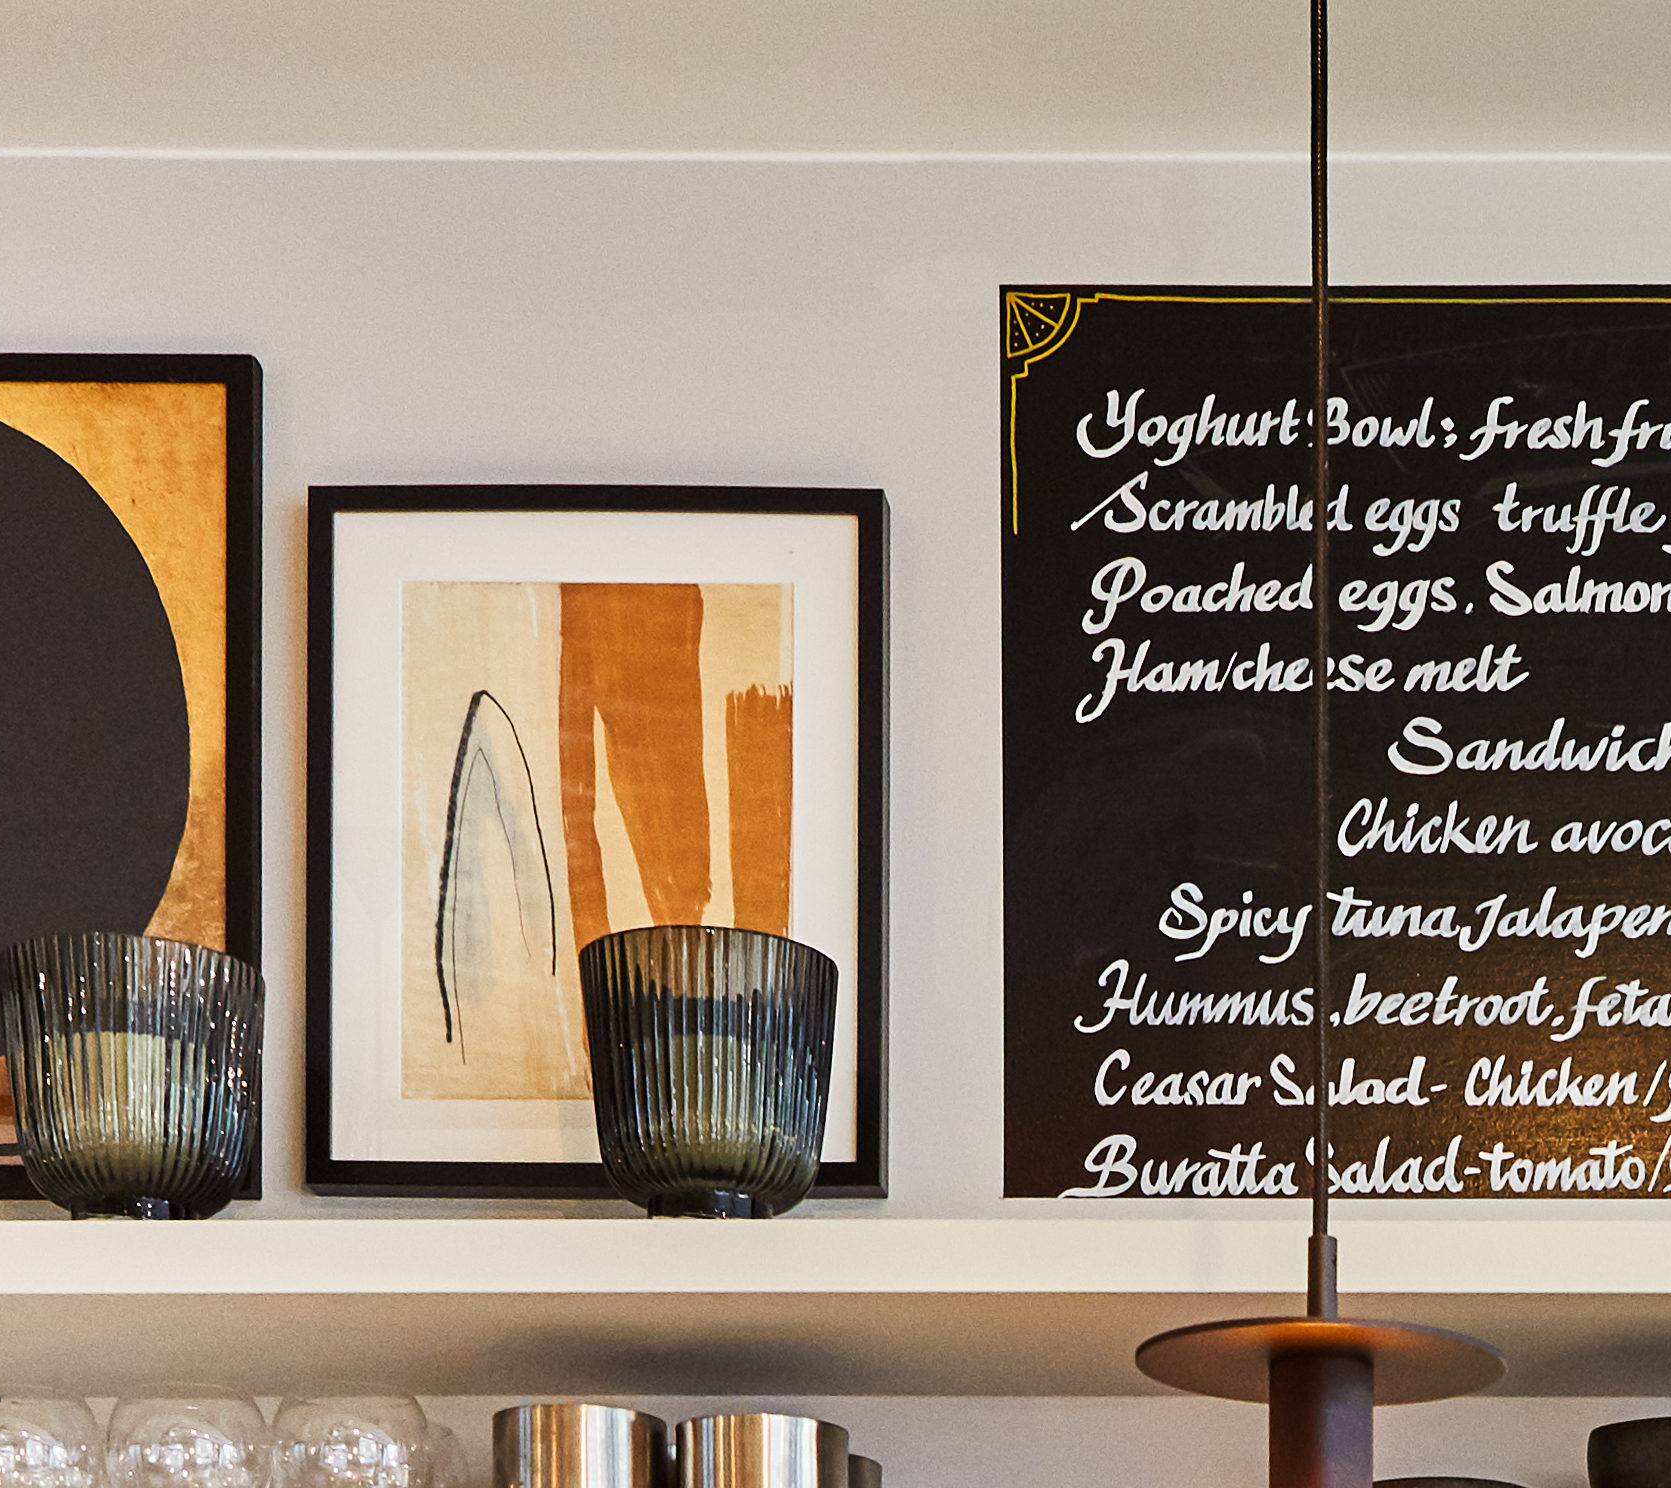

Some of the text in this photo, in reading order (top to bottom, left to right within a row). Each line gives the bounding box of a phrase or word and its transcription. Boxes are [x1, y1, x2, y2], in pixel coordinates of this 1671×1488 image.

[1076, 388, 1301, 467] Yoghurt
[1364, 497, 1461, 557] eggs
[1492, 481, 1667, 557] truffle
[1081, 556, 1314, 635] Poached
[1403, 643, 1530, 693] melt
[1337, 796, 1539, 857] Chicken
[1158, 882, 1313, 964] Spicy
[1094, 1048, 1262, 1107] Ceasar
[1058, 1133, 1299, 1197] Buratta
